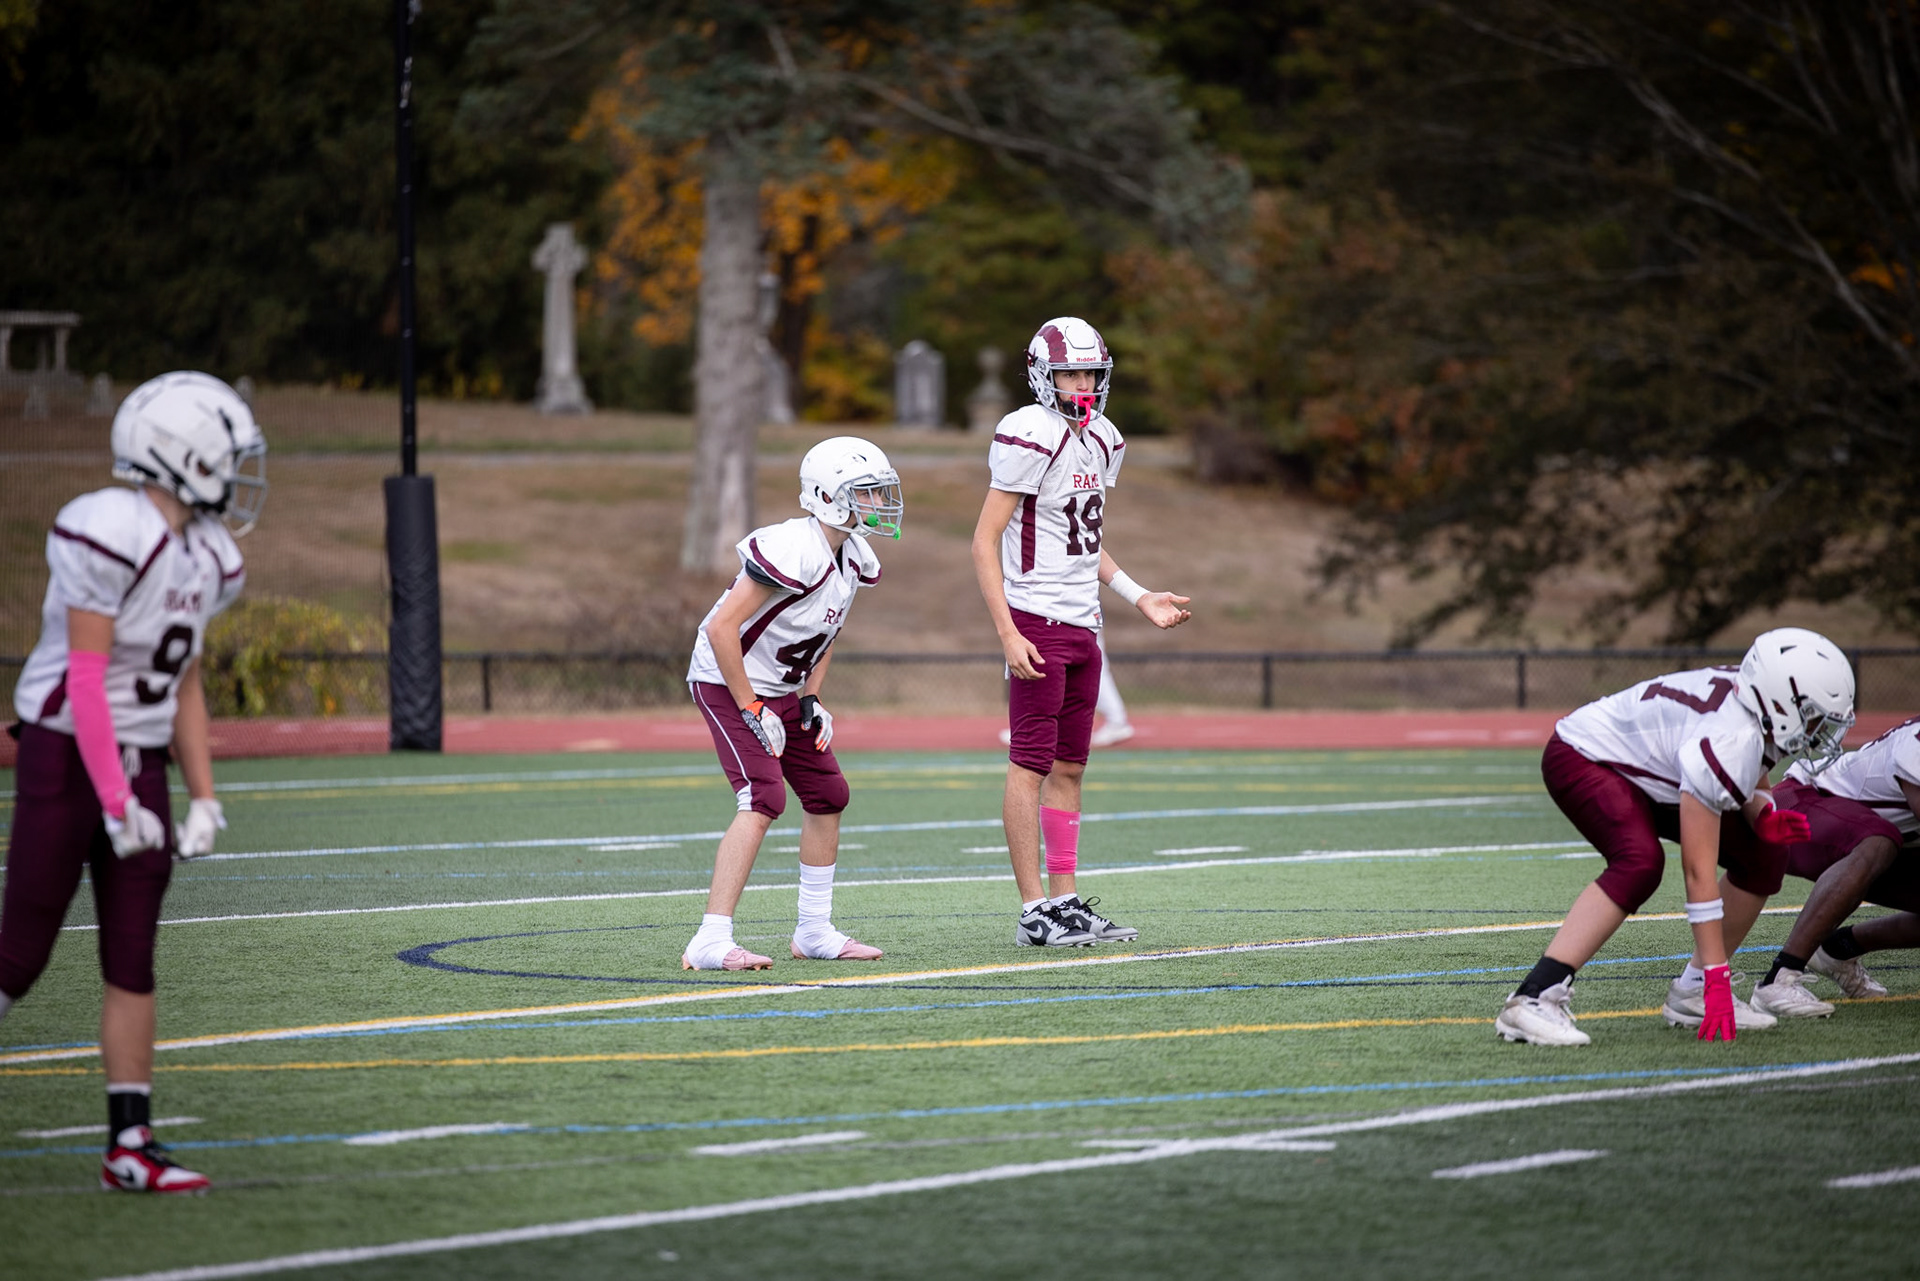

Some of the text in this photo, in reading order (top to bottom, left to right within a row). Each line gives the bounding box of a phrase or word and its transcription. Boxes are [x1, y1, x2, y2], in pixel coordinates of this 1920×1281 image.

[1062, 494, 1103, 556] 19
[135, 624, 193, 705] 9
[775, 627, 842, 685] 4
[1640, 665, 1740, 715] 7
